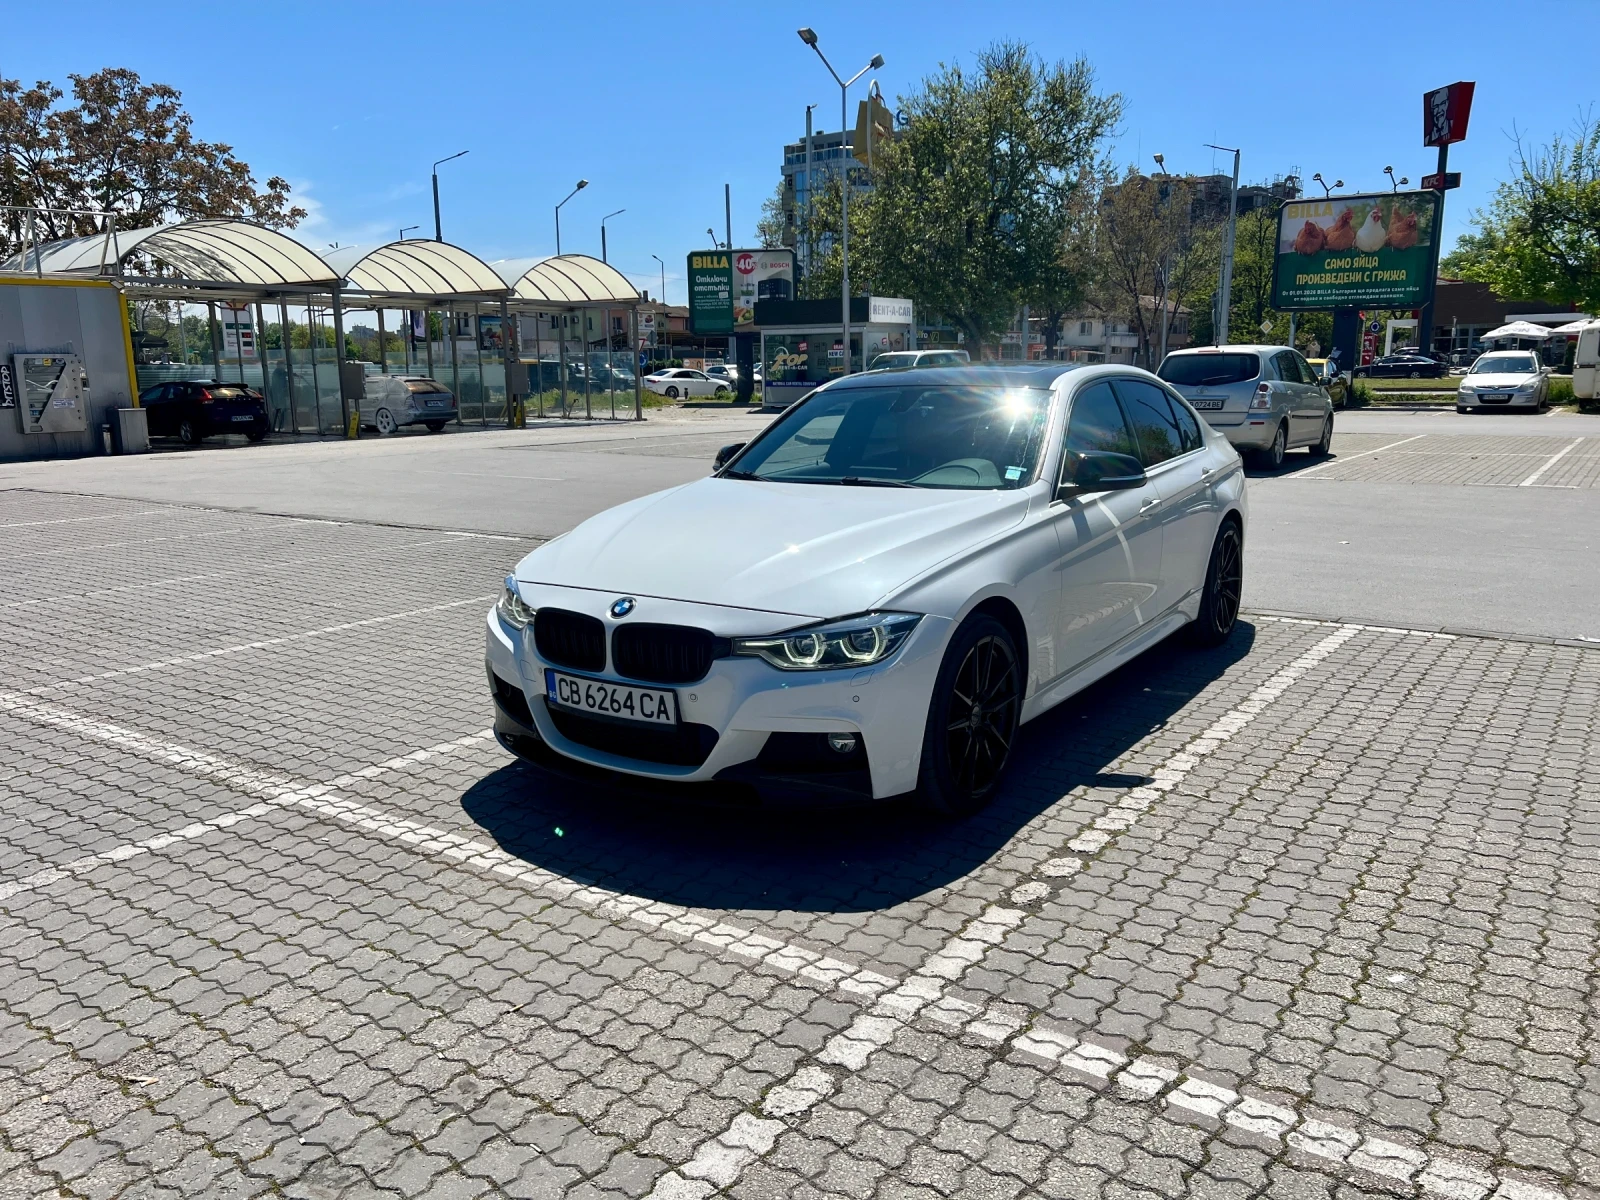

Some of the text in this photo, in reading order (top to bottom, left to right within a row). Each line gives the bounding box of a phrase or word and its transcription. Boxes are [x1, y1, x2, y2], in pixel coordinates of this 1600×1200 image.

[1422, 176, 1440, 187] KFC
[1287, 202, 1333, 219] BILLA
[692, 256, 729, 268] BILLA
[1324, 254, 1379, 270] САМО ЯЙЦА
[695, 275, 728, 283] Отключи
[1296, 269, 1407, 285] ПРОИЗВЕДЕНИ С ГРИЖА
[872, 304, 911, 317] RENT-A-CAR
[770, 353, 808, 371] TOP
[558, 678, 670, 721] CB 6264 CA
